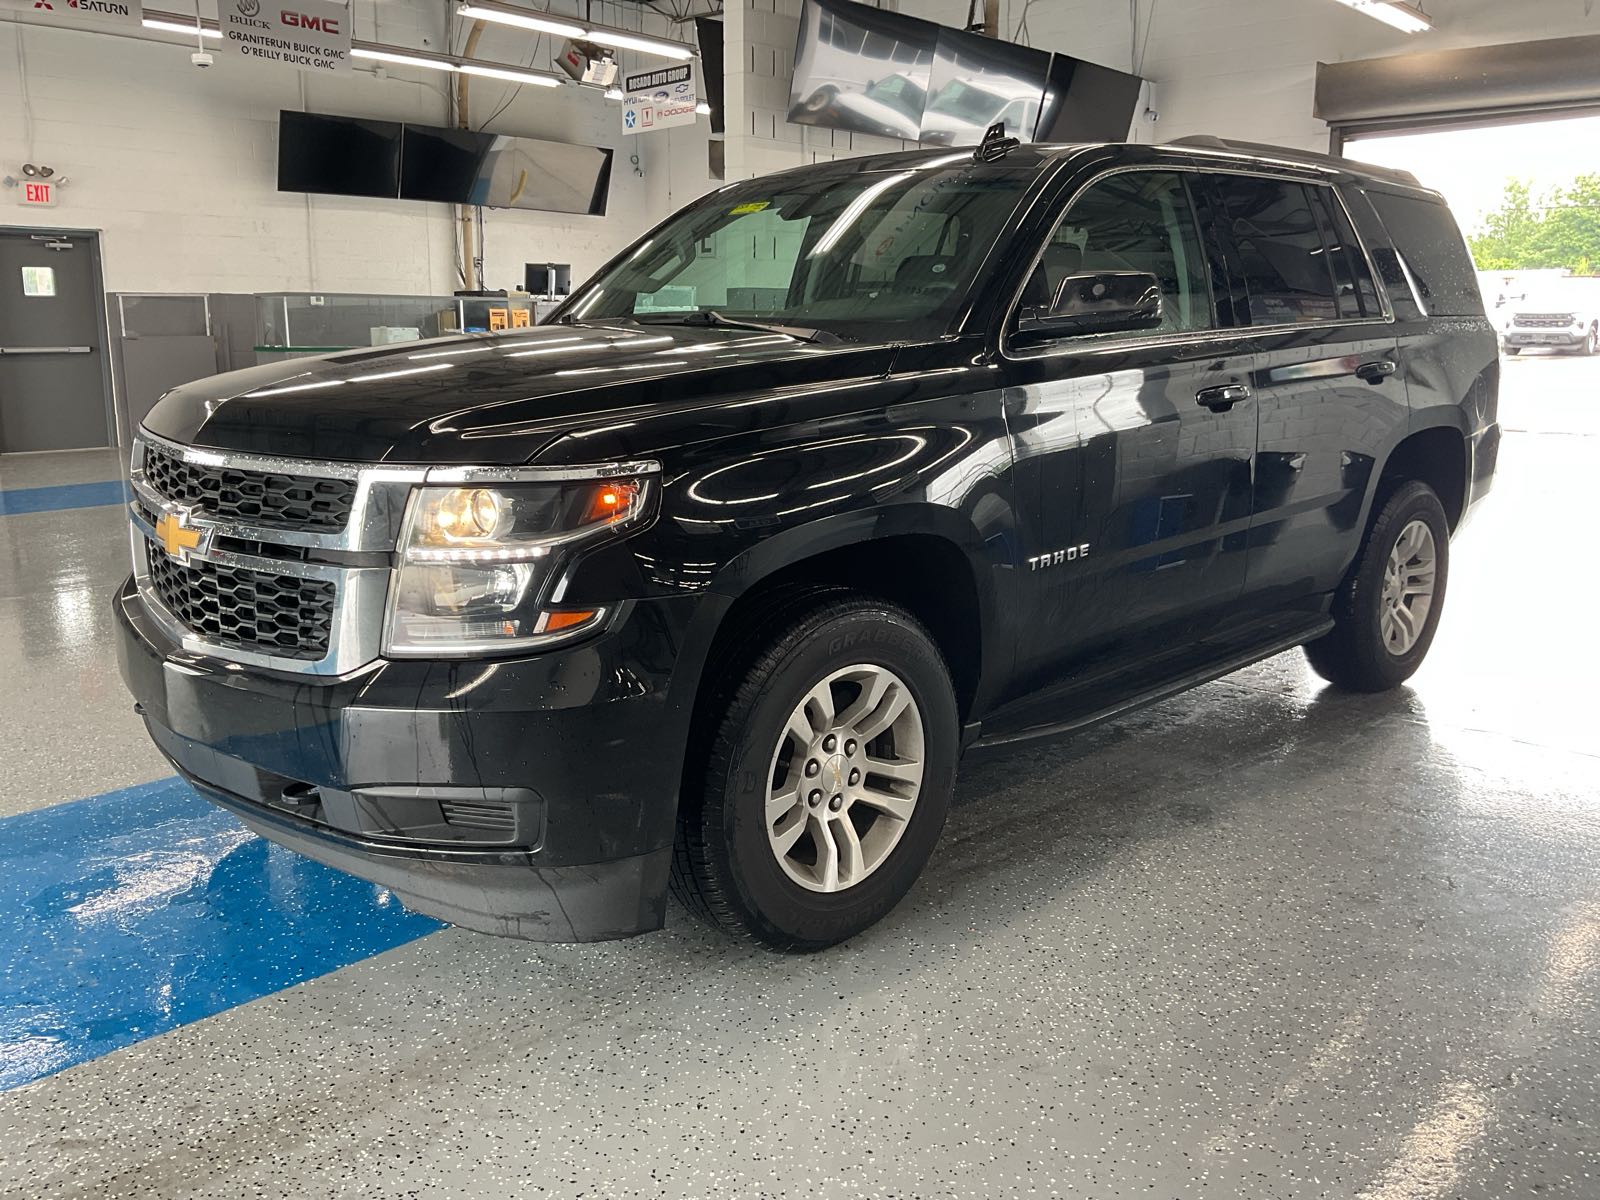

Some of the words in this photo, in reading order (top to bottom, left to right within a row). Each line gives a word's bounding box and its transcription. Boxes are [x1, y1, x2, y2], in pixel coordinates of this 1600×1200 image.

[80, 0, 128, 16] SATURN
[229, 15, 271, 30] BUICK
[280, 9, 340, 34] GMC
[228, 30, 291, 50] GRANITERUN
[293, 42, 321, 55] BUICK
[323, 48, 345, 60] GMC
[241, 45, 280, 60] O'REILLY
[283, 53, 311, 66] BUICK
[313, 58, 335, 70] GMC
[652, 72, 667, 85] AUTO
[668, 67, 688, 81] GROUP
[664, 105, 695, 116] DODGE
[26, 184, 50, 203] EXIT
[1028, 543, 1090, 571] TAHOE
